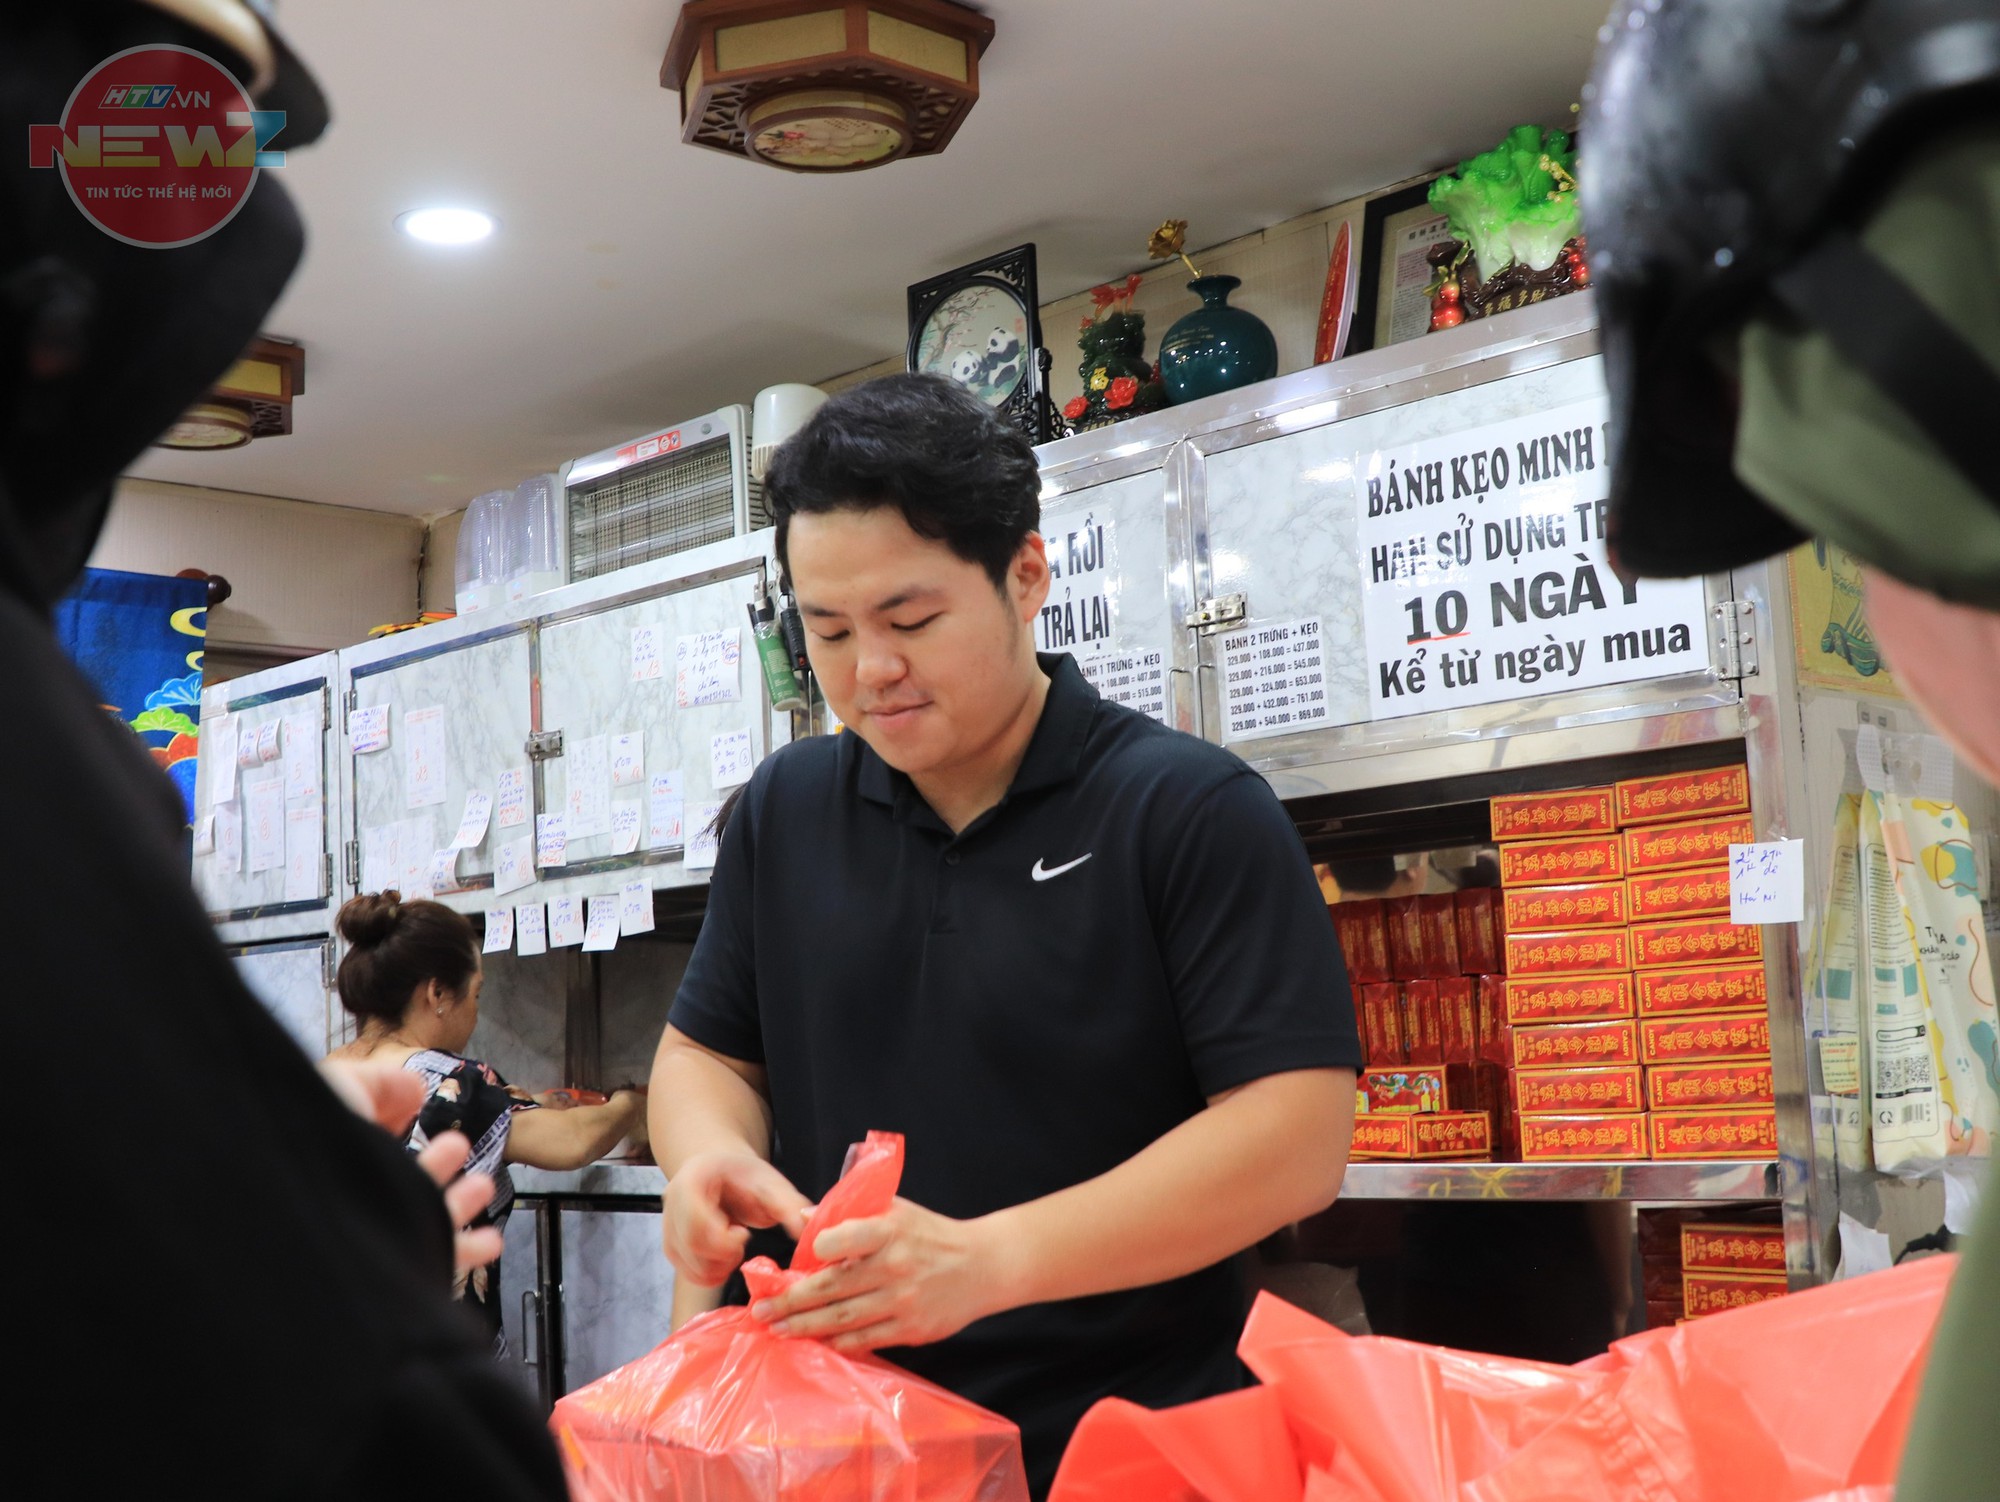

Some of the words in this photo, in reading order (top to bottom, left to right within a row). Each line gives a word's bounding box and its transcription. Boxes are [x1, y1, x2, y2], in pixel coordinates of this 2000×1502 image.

[1367, 459, 1444, 518] BÁNH
[1450, 446, 1510, 504] KẸO
[1517, 426, 1595, 485] MINH
[1436, 512, 1474, 570] SỬ
[1484, 513, 1566, 565] DỤNG
[1041, 586, 1076, 650] TRẢ
[1081, 594, 1110, 650] LẠI
[1404, 590, 1468, 643] 10
[1490, 552, 1640, 628] NGÀY
[1100, 664, 1104, 675] 1
[1106, 658, 1133, 673] TRỨNG
[1143, 653, 1161, 668] KẸO
[1225, 636, 1248, 651] BÁNH
[1250, 634, 1256, 646] 2
[1259, 628, 1288, 645] TRỨNG
[1300, 621, 1319, 638] KẸO
[1379, 647, 1427, 698] Kể
[1439, 648, 1482, 688] từ
[1494, 633, 1586, 683] ngày
[1602, 623, 1691, 663] mua
